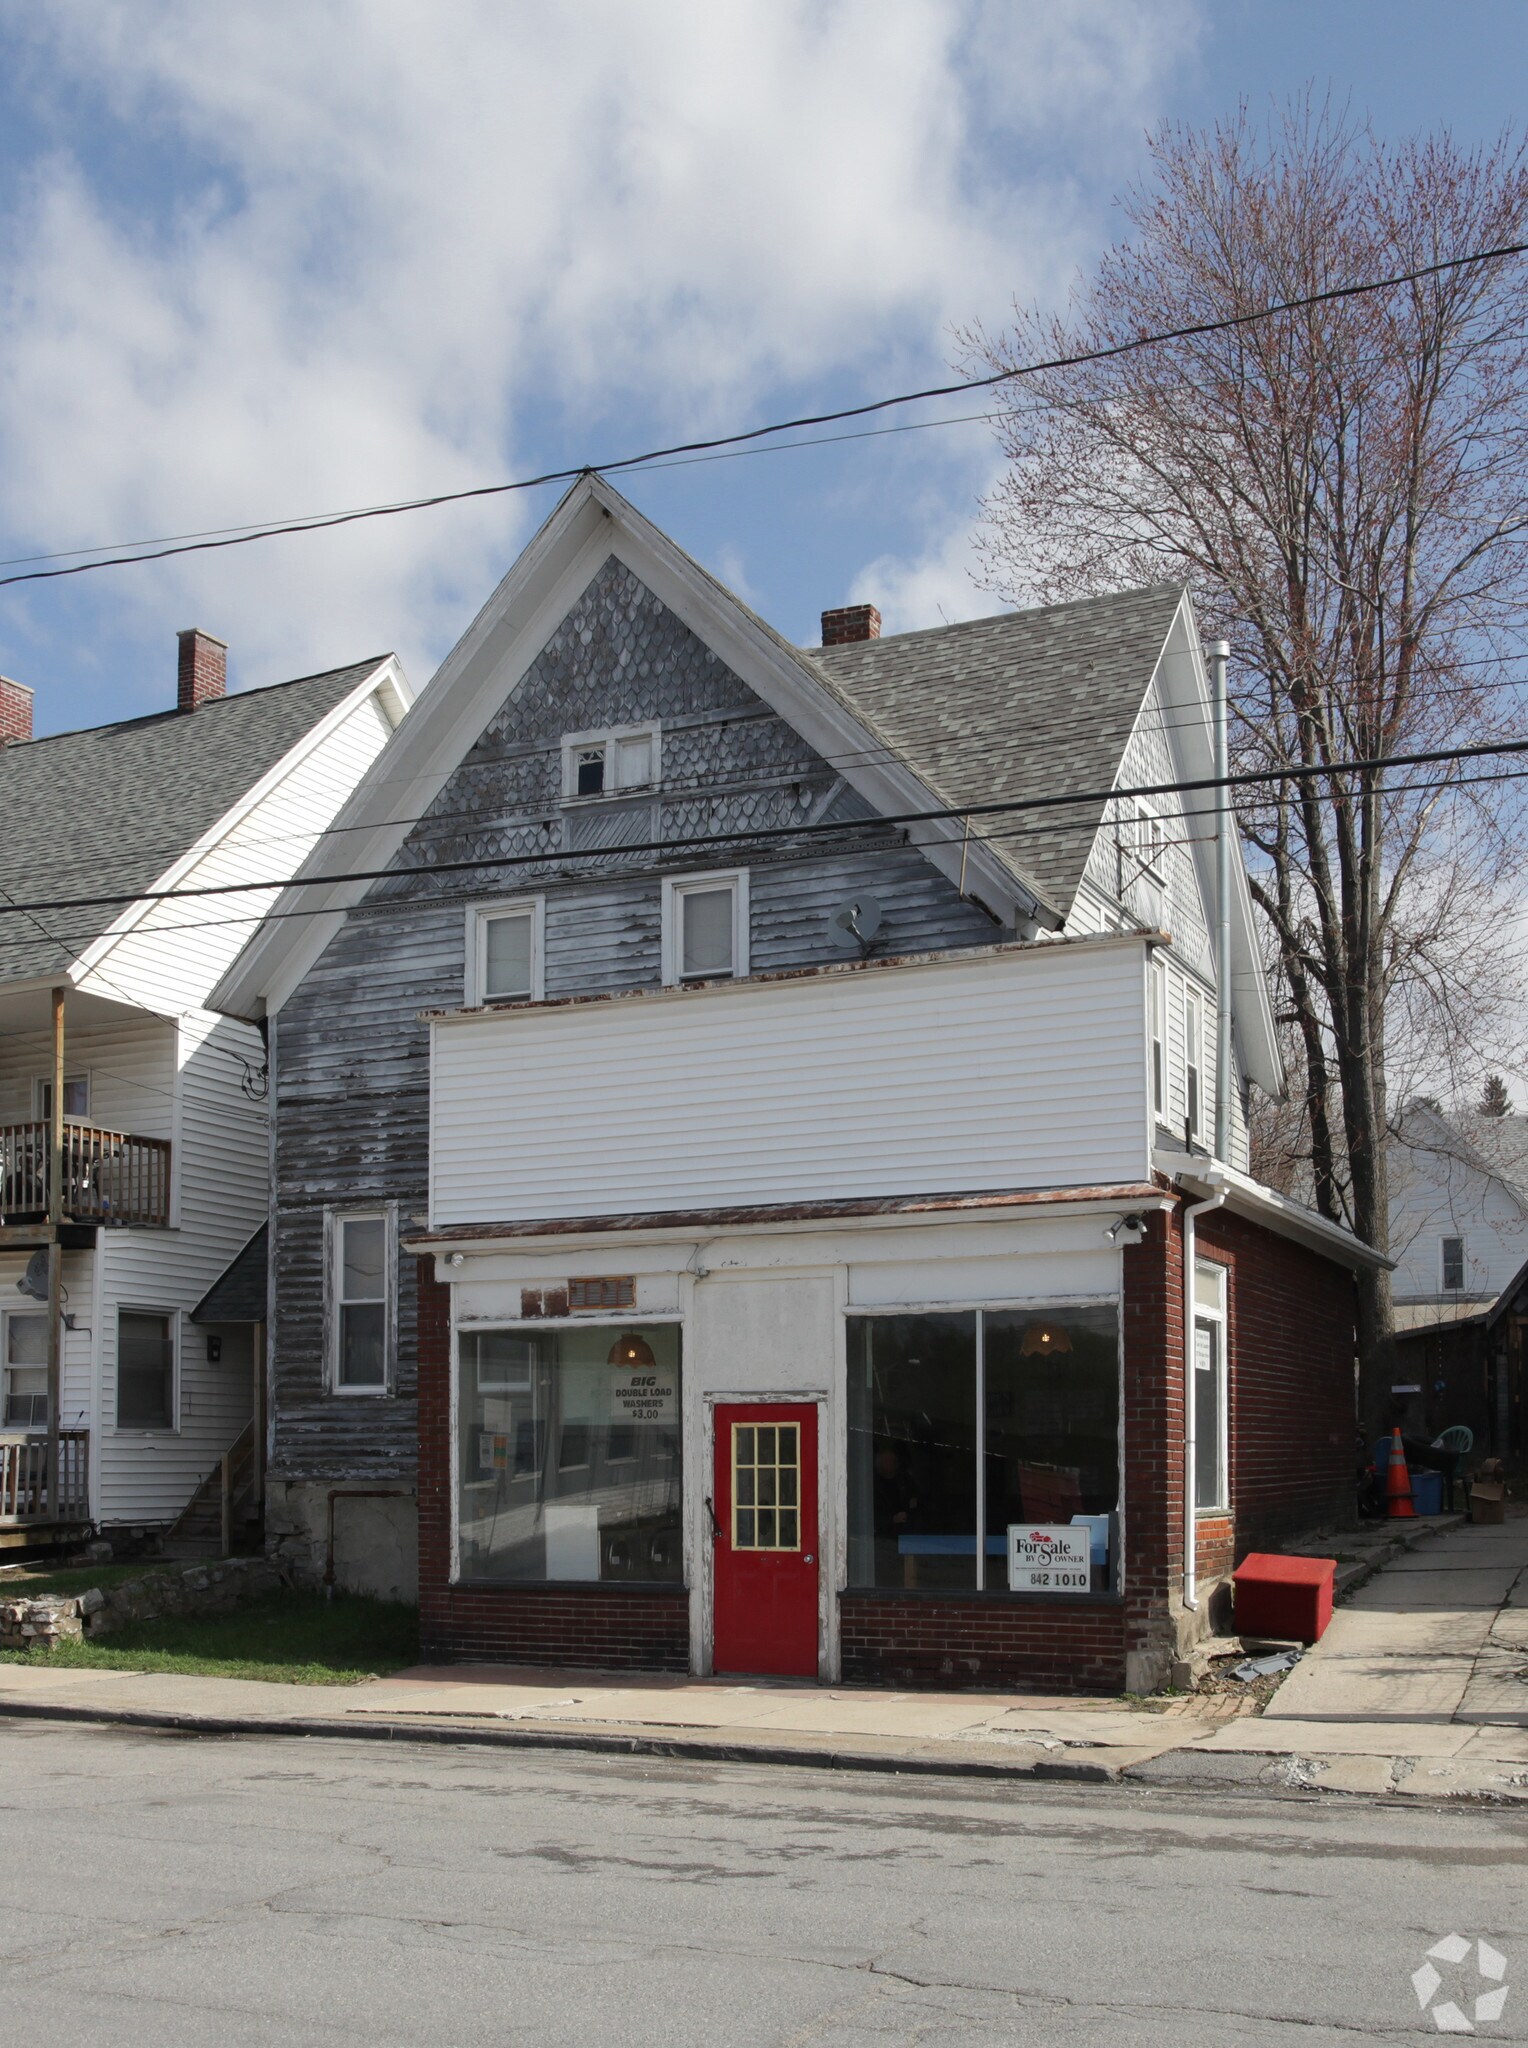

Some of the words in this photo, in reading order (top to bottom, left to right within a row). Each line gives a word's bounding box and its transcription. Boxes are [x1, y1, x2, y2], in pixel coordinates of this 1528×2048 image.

[631, 1377, 656, 1386] BIG
[616, 1389, 647, 1397] DOUBLE
[651, 1388, 671, 1396] LOAD
[623, 1400, 663, 1408] WASHERS
[632, 1409, 658, 1419] $3.00
[1016, 1539, 1039, 1553] For
[1038, 1540, 1071, 1566] Sale
[1055, 1555, 1085, 1563] OWNER
[1031, 1573, 1049, 1585] 842
[1055, 1574, 1087, 1586] 1010
